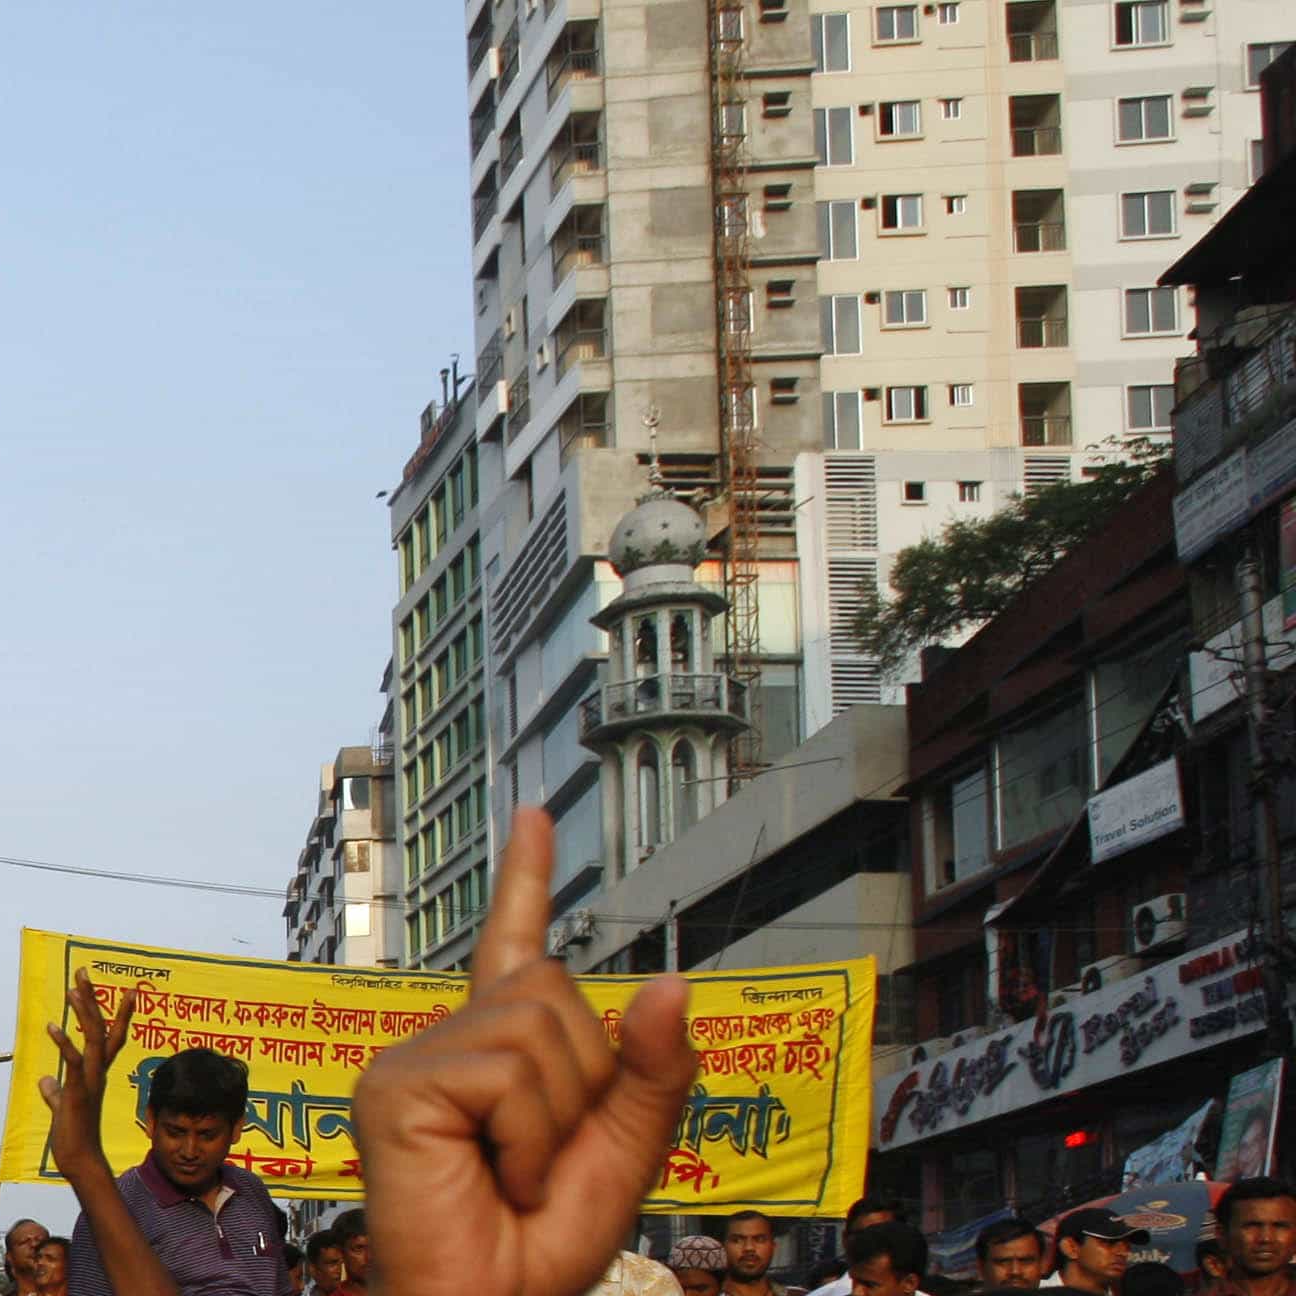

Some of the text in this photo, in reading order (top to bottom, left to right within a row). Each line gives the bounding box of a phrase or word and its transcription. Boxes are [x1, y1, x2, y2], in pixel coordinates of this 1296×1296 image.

[1095, 803, 1177, 847] Travel Solution
[92, 960, 171, 981] বাংলাদেশ
[741, 986, 824, 1005] জিন্দাবাদ
[311, 999, 376, 1035] ইসলাম
[797, 1007, 835, 1031] এবং
[258, 1036, 327, 1068] সালাম
[331, 1042, 366, 1071] সহ
